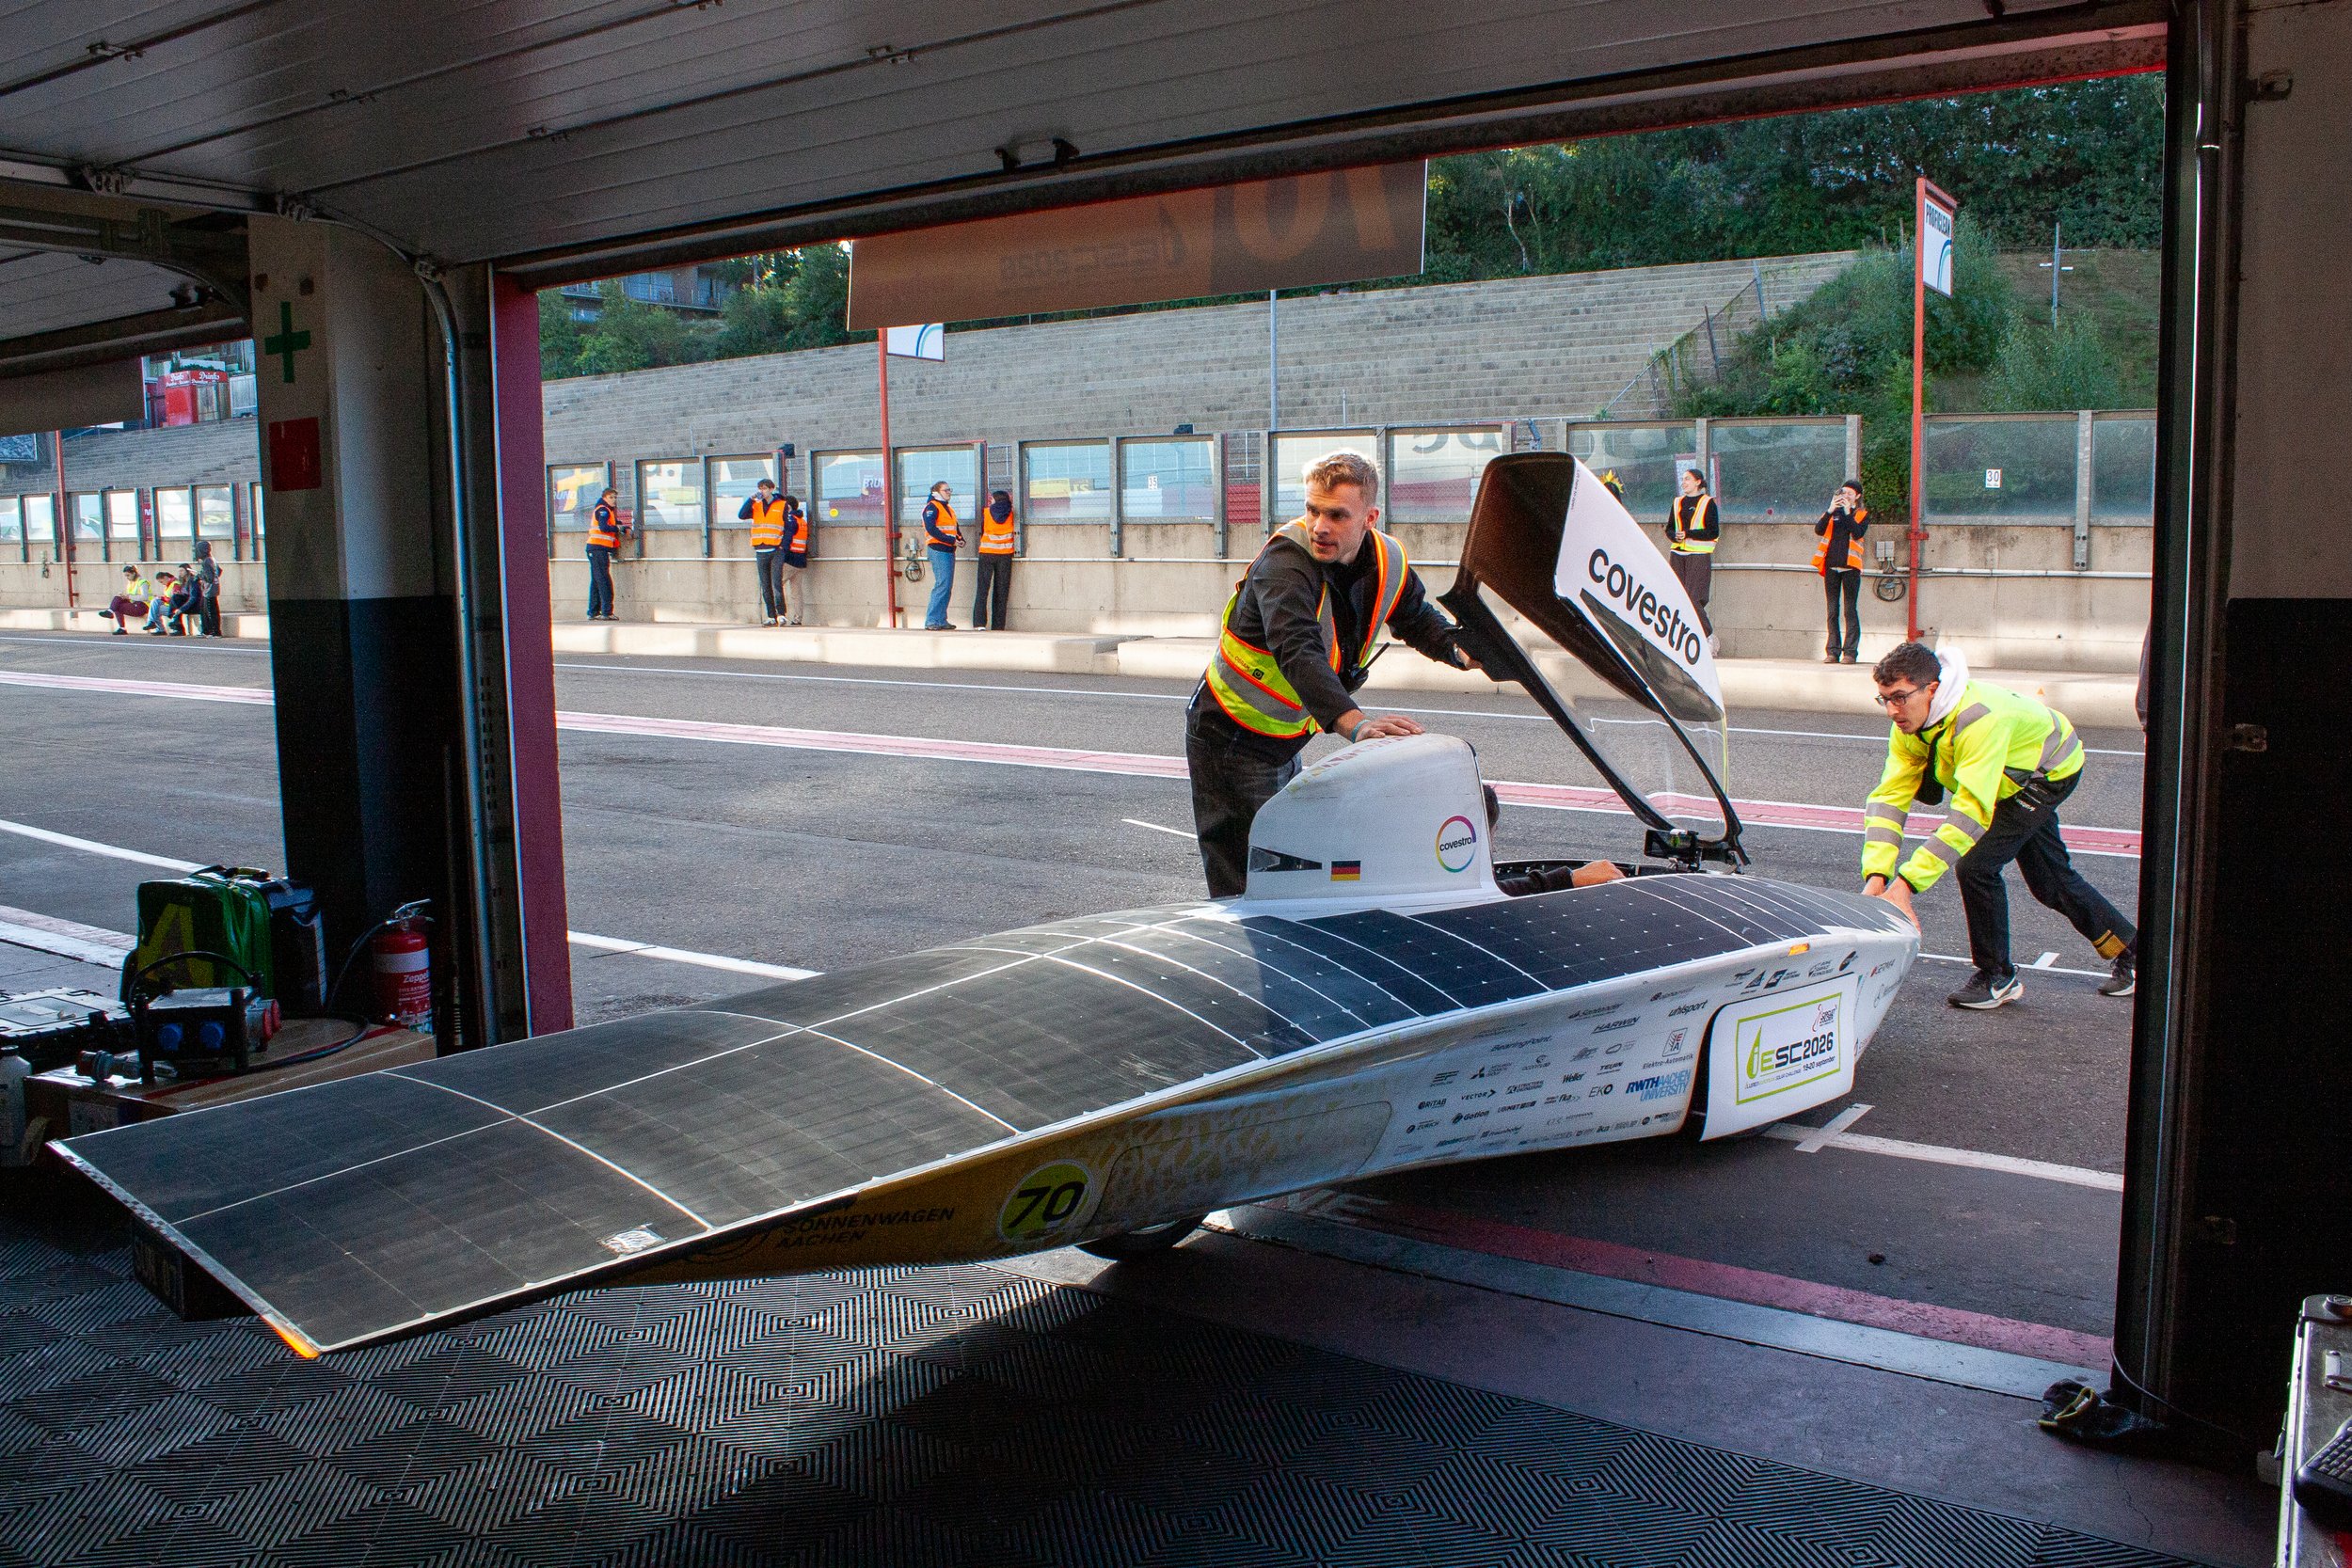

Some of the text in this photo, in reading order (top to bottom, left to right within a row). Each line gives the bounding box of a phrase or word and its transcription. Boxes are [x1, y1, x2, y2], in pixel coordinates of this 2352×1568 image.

[1149, 477, 1157, 487] 35
[1987, 470, 2000, 482] 30
[1588, 548, 1701, 665] covestro
[1234, 656, 1250, 672] OSRAM
[1438, 836, 1472, 852] covestro
[1668, 999, 1708, 1017] uhlsport
[1594, 1016, 1641, 1032] HARWIN
[1675, 1033, 1682, 1042] E
[1672, 1042, 1679, 1051] A
[1643, 1053, 1693, 1069] Elektro-Automatik
[1747, 1031, 1834, 1079] iESC2026
[1816, 1054, 1836, 1069] september
[1563, 1071, 1587, 1084] Weller
[1626, 1069, 1691, 1094] RWTH AACHEN
[1461, 1091, 1487, 1101] VECTOR
[1588, 1084, 1613, 1098] EKO
[1640, 1083, 1688, 1101] UNIVERSITY
[1463, 1110, 1490, 1120] Gotion
[1007, 1180, 1086, 1228] 70
[783, 1207, 955, 1233] SONNENWAGEN
[776, 1229, 866, 1250] AACHEN
